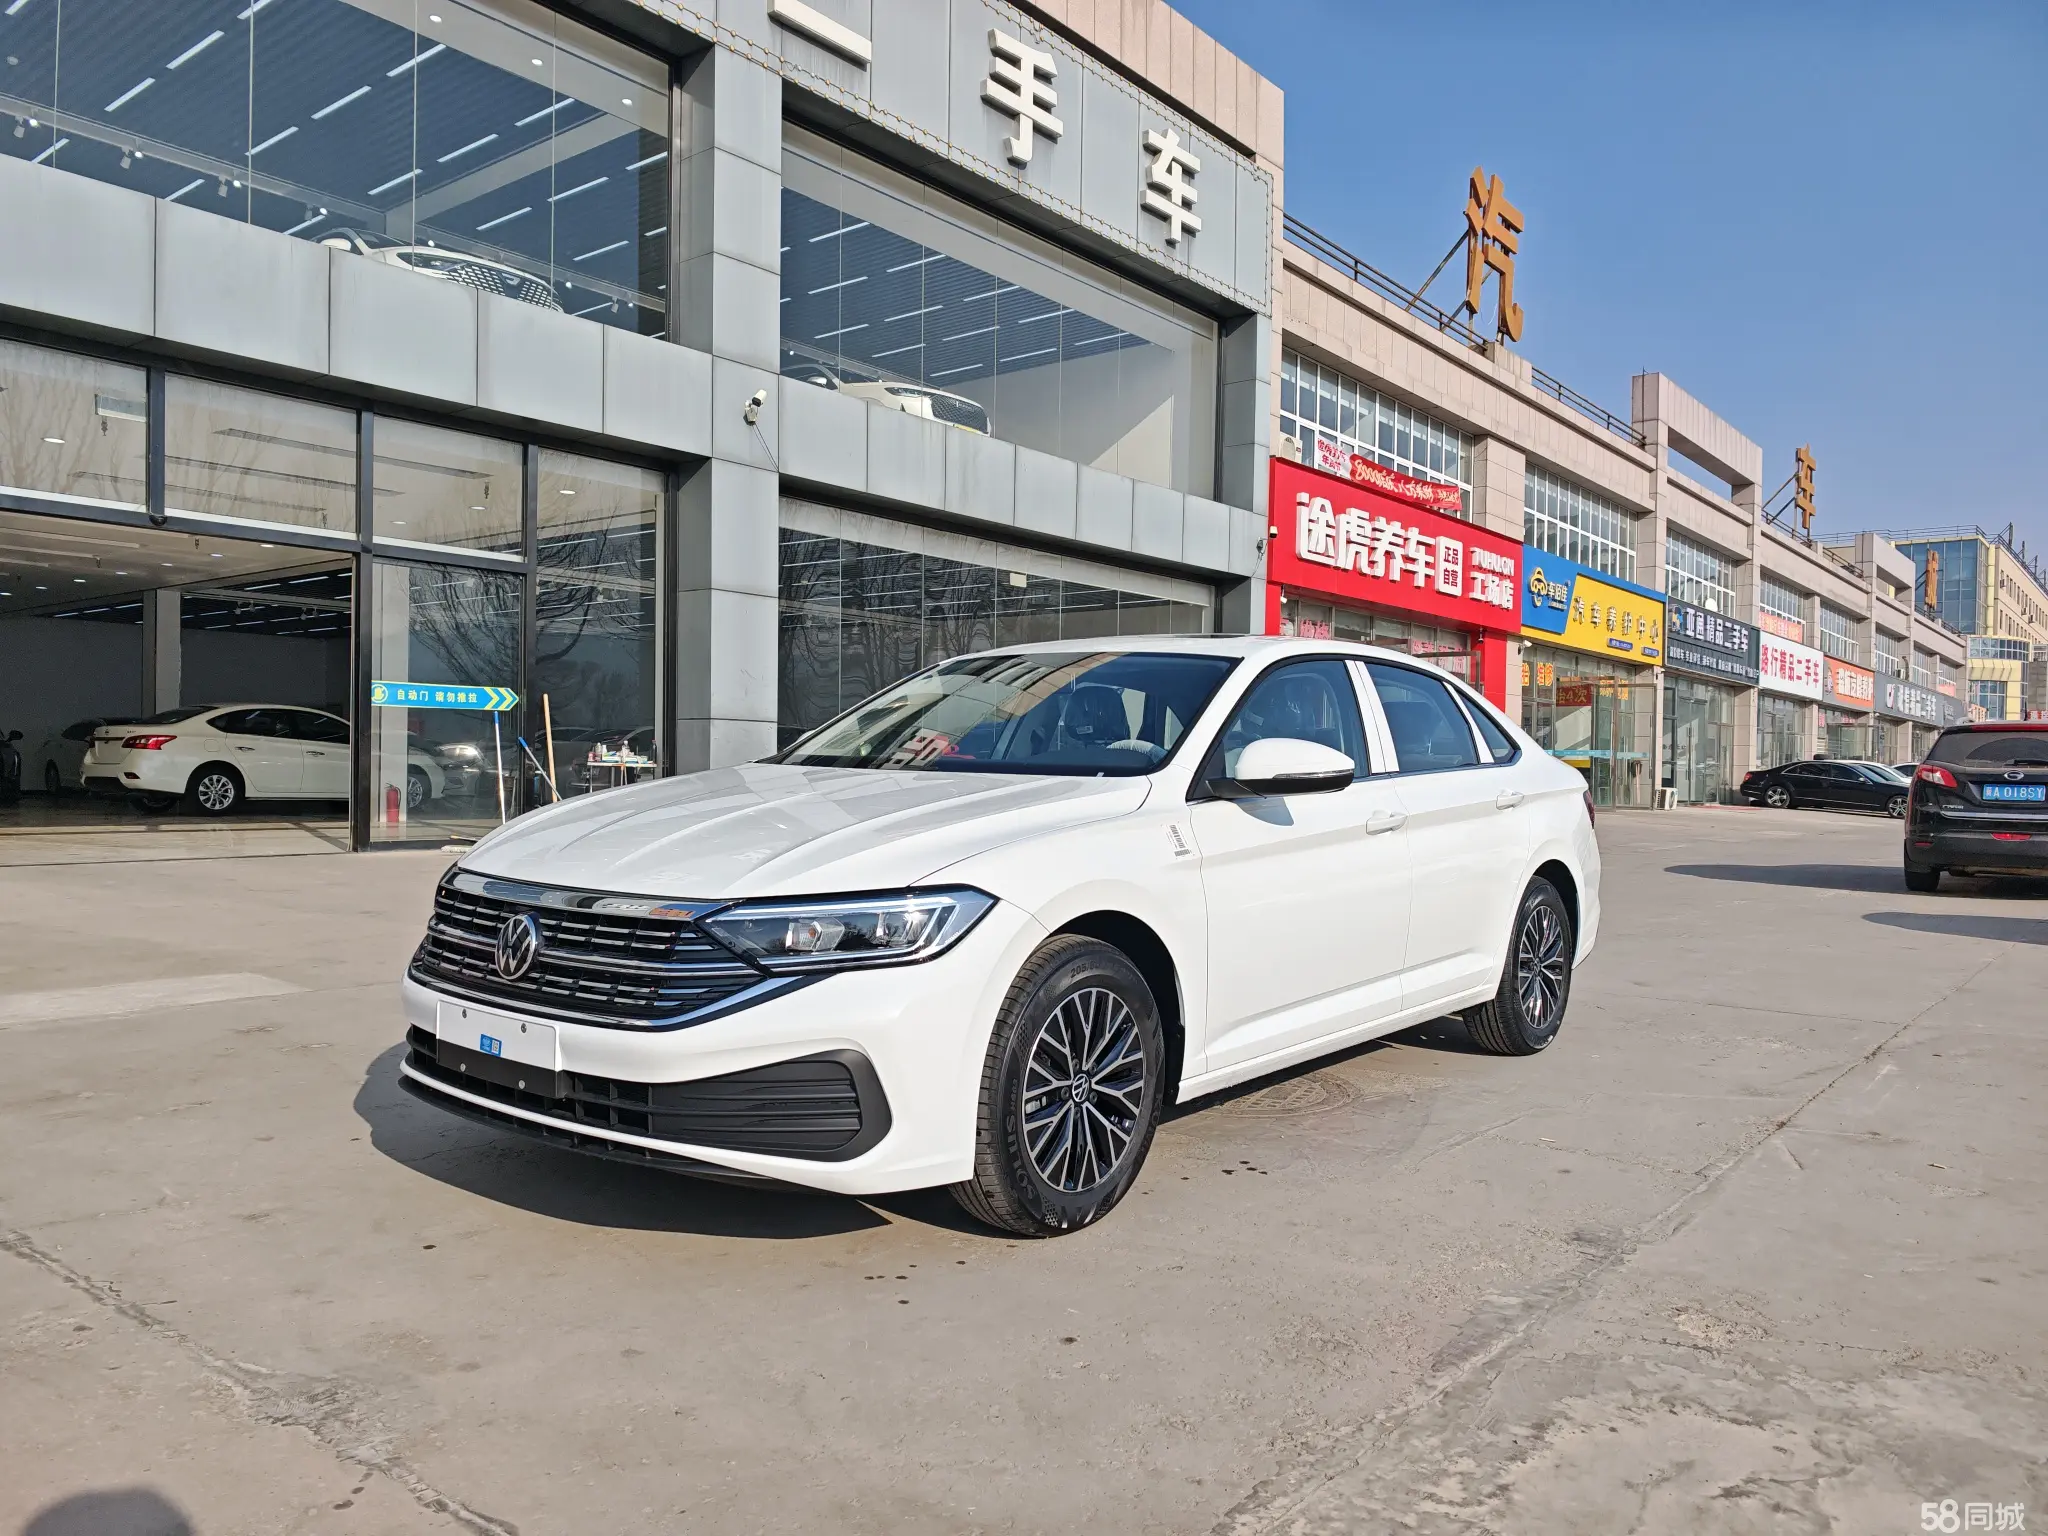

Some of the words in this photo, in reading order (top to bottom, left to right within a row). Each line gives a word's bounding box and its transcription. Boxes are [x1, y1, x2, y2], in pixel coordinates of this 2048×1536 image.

[1463, 165, 1525, 342] 汽
[1796, 443, 1817, 530] 车
[1296, 492, 1436, 588] 途虎养车
[1443, 545, 1459, 567] 正品
[1443, 567, 1459, 588] 自营
[1469, 571, 1514, 611] 工场店
[1573, 596, 1659, 644] 汽车养护中心
[1686, 607, 1749, 653] 亚通精品二手车
[396, 689, 429, 700] 自动门
[434, 691, 478, 703] 请勿推拉
